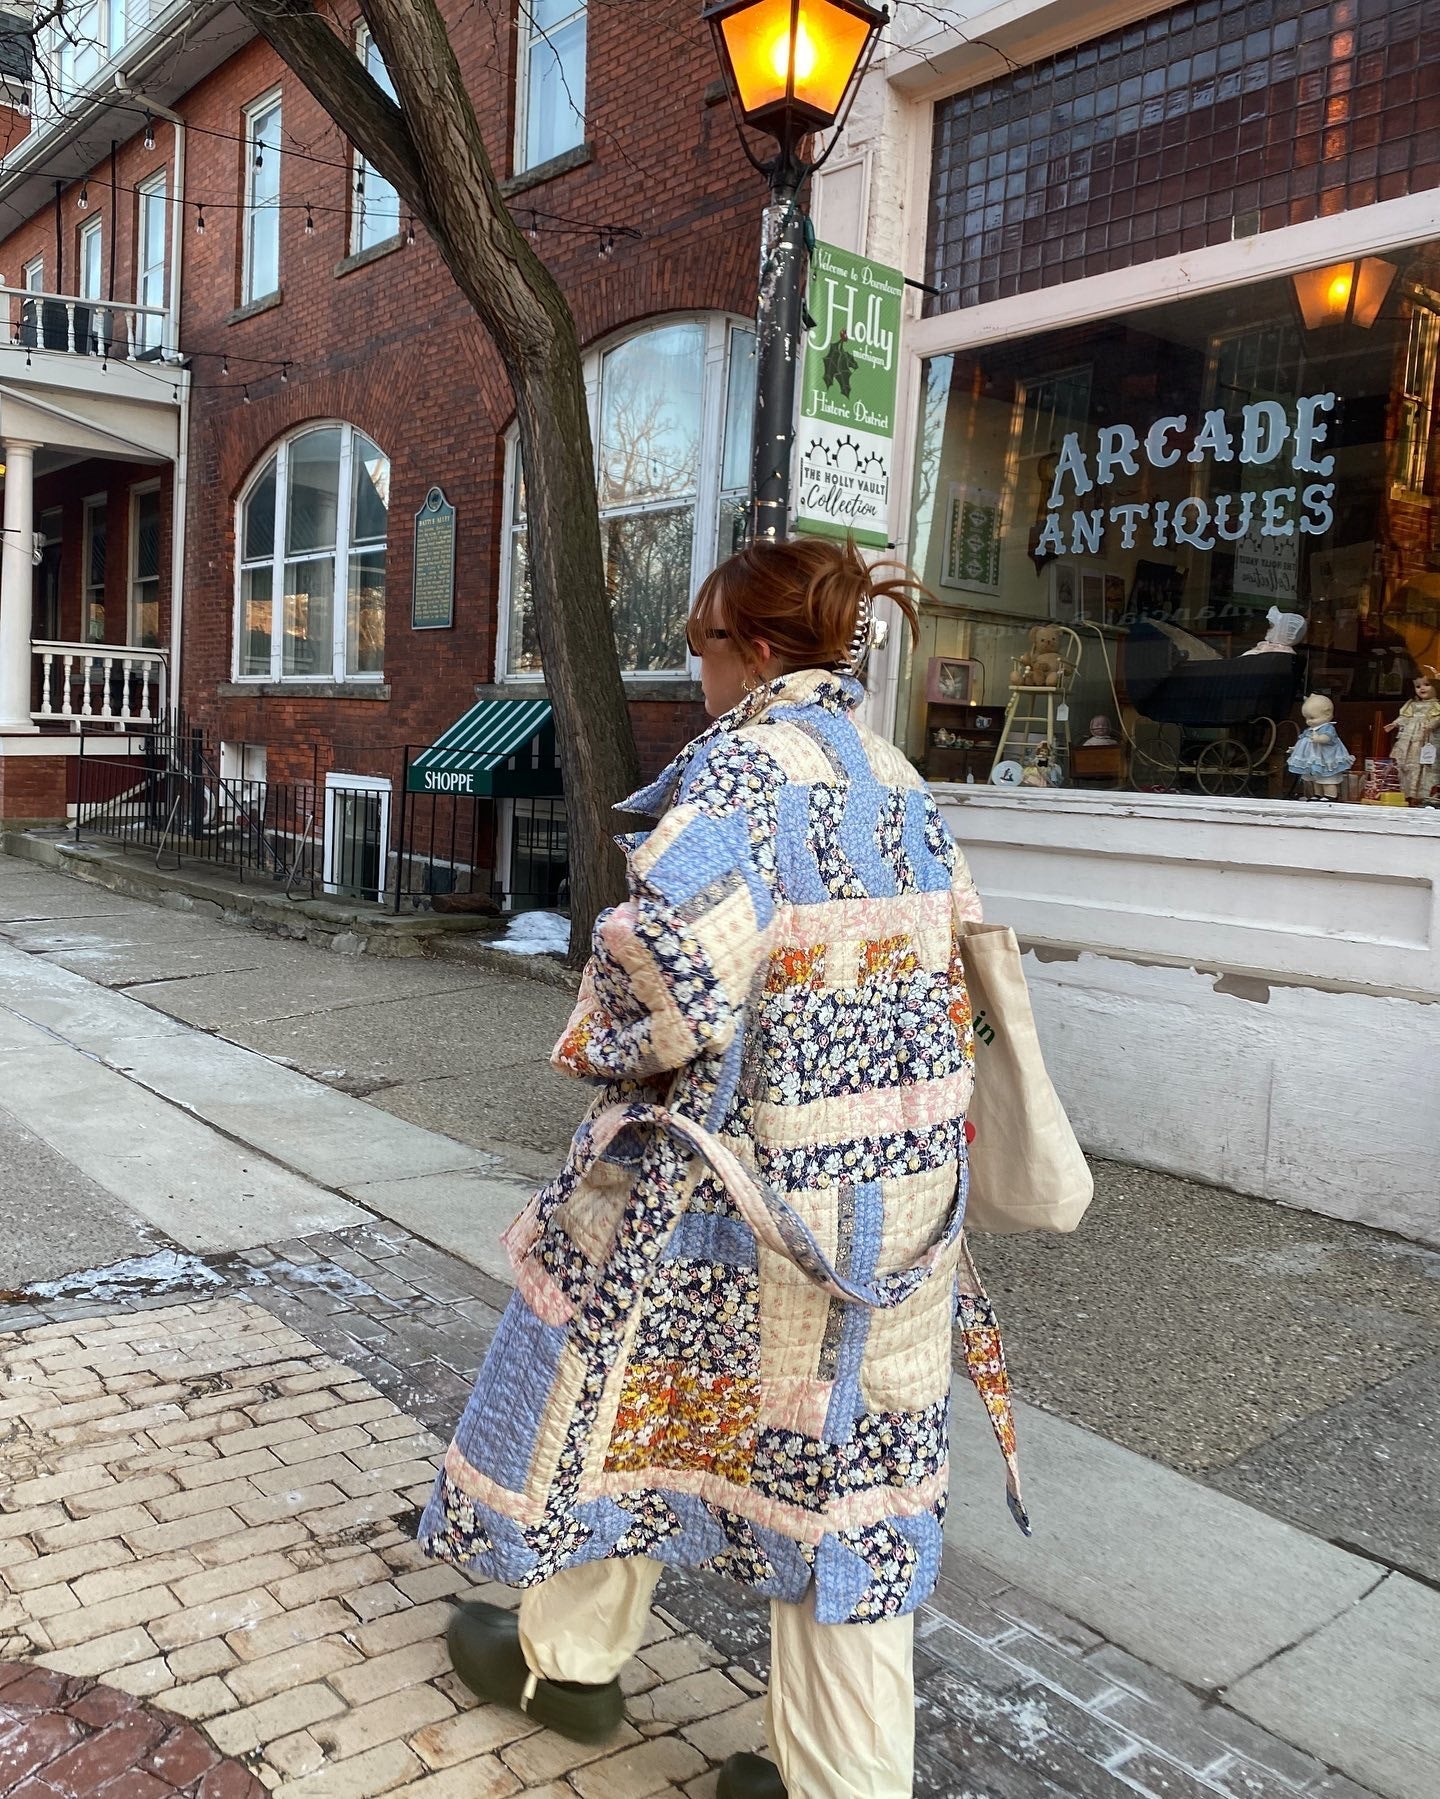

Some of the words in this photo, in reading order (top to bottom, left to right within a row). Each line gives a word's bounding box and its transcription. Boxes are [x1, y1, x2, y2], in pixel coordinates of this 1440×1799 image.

[813, 247, 848, 278] Welcome
[851, 267, 859, 281] to
[861, 265, 902, 297] Downtown
[808, 277, 893, 371] Holly
[853, 345, 885, 369] michigan
[806, 389, 850, 419] Historic
[853, 399, 888, 429] District
[1047, 392, 1335, 509] ARCADE
[804, 467, 822, 482] THE
[825, 471, 855, 489] HOLLY
[858, 479, 886, 496] VAULT
[807, 483, 878, 518] Collection
[1035, 482, 1336, 556] ANTIQUES
[424, 771, 474, 793] SHOPPE
